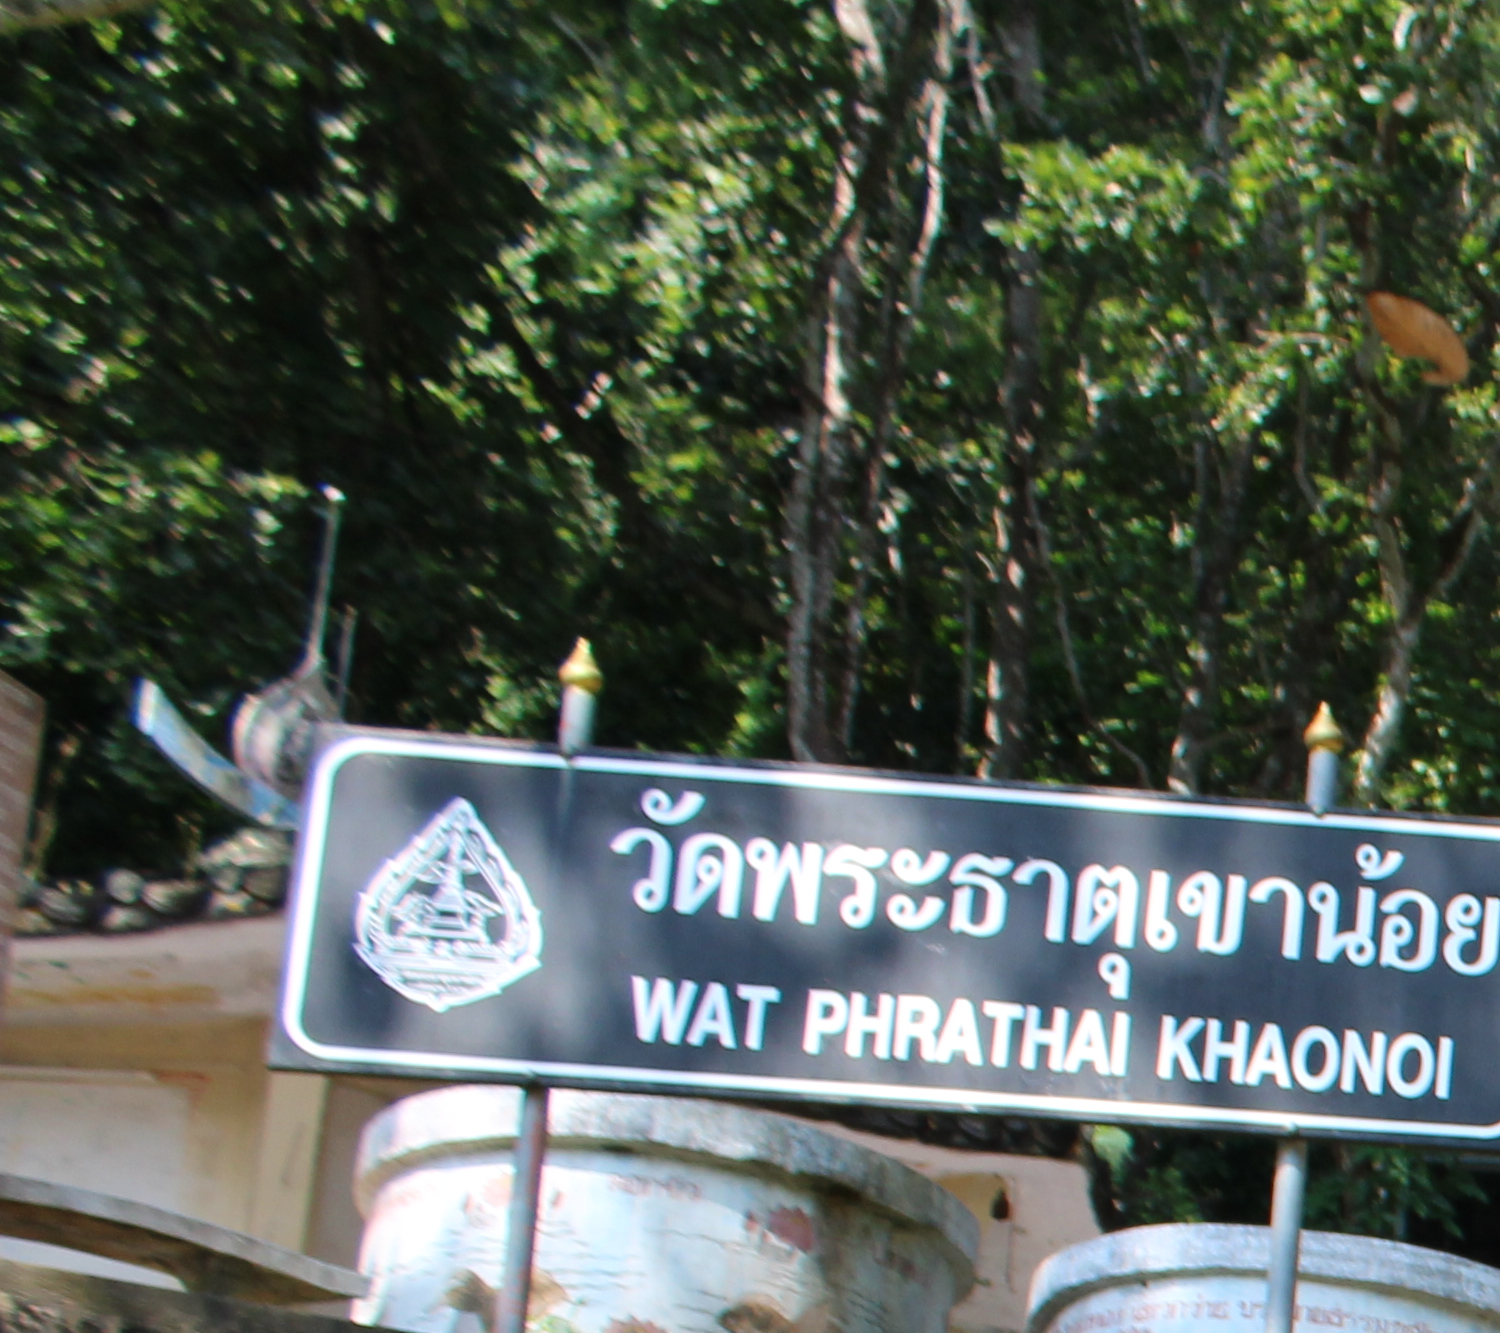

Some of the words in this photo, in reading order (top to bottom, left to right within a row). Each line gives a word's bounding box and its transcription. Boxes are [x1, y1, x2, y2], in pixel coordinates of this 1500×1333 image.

[631, 976, 780, 1050] WAT
[801, 990, 1129, 1077] PHRATHAI
[1156, 1014, 1454, 1100] KHAONOI
